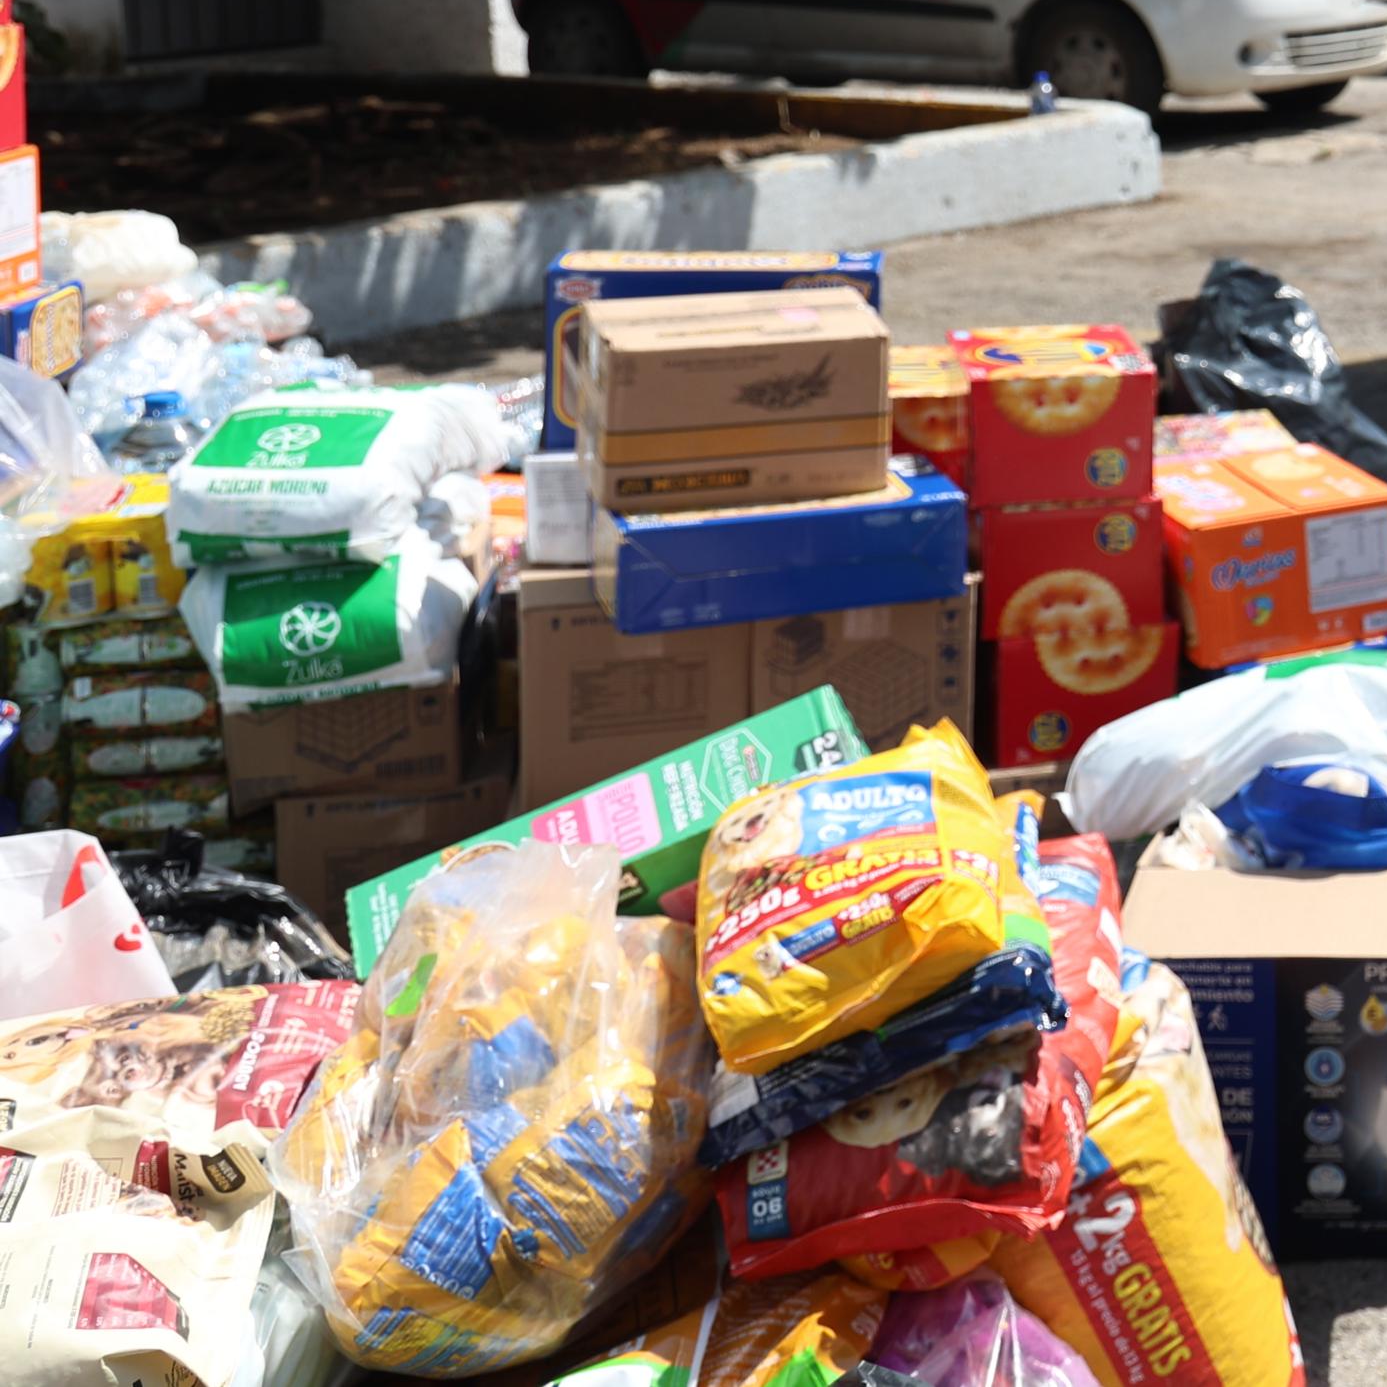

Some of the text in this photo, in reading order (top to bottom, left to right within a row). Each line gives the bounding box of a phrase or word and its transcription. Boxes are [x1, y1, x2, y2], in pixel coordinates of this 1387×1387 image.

[282, 655, 343, 685] Zulka
[811, 782, 928, 812] ADULTO
[614, 790, 646, 847] POLLO
[232, 1031, 266, 1092] ADULTOS
[1222, 1087, 1254, 1107] DE
[752, 1196, 782, 1218] 06
[1077, 1265, 1093, 1287] kg
[1086, 1280, 1104, 1298] al
[1091, 1297, 1122, 1338] precio
[1113, 1262, 1193, 1377] GRATIS
[1114, 1336, 1131, 1355] de
